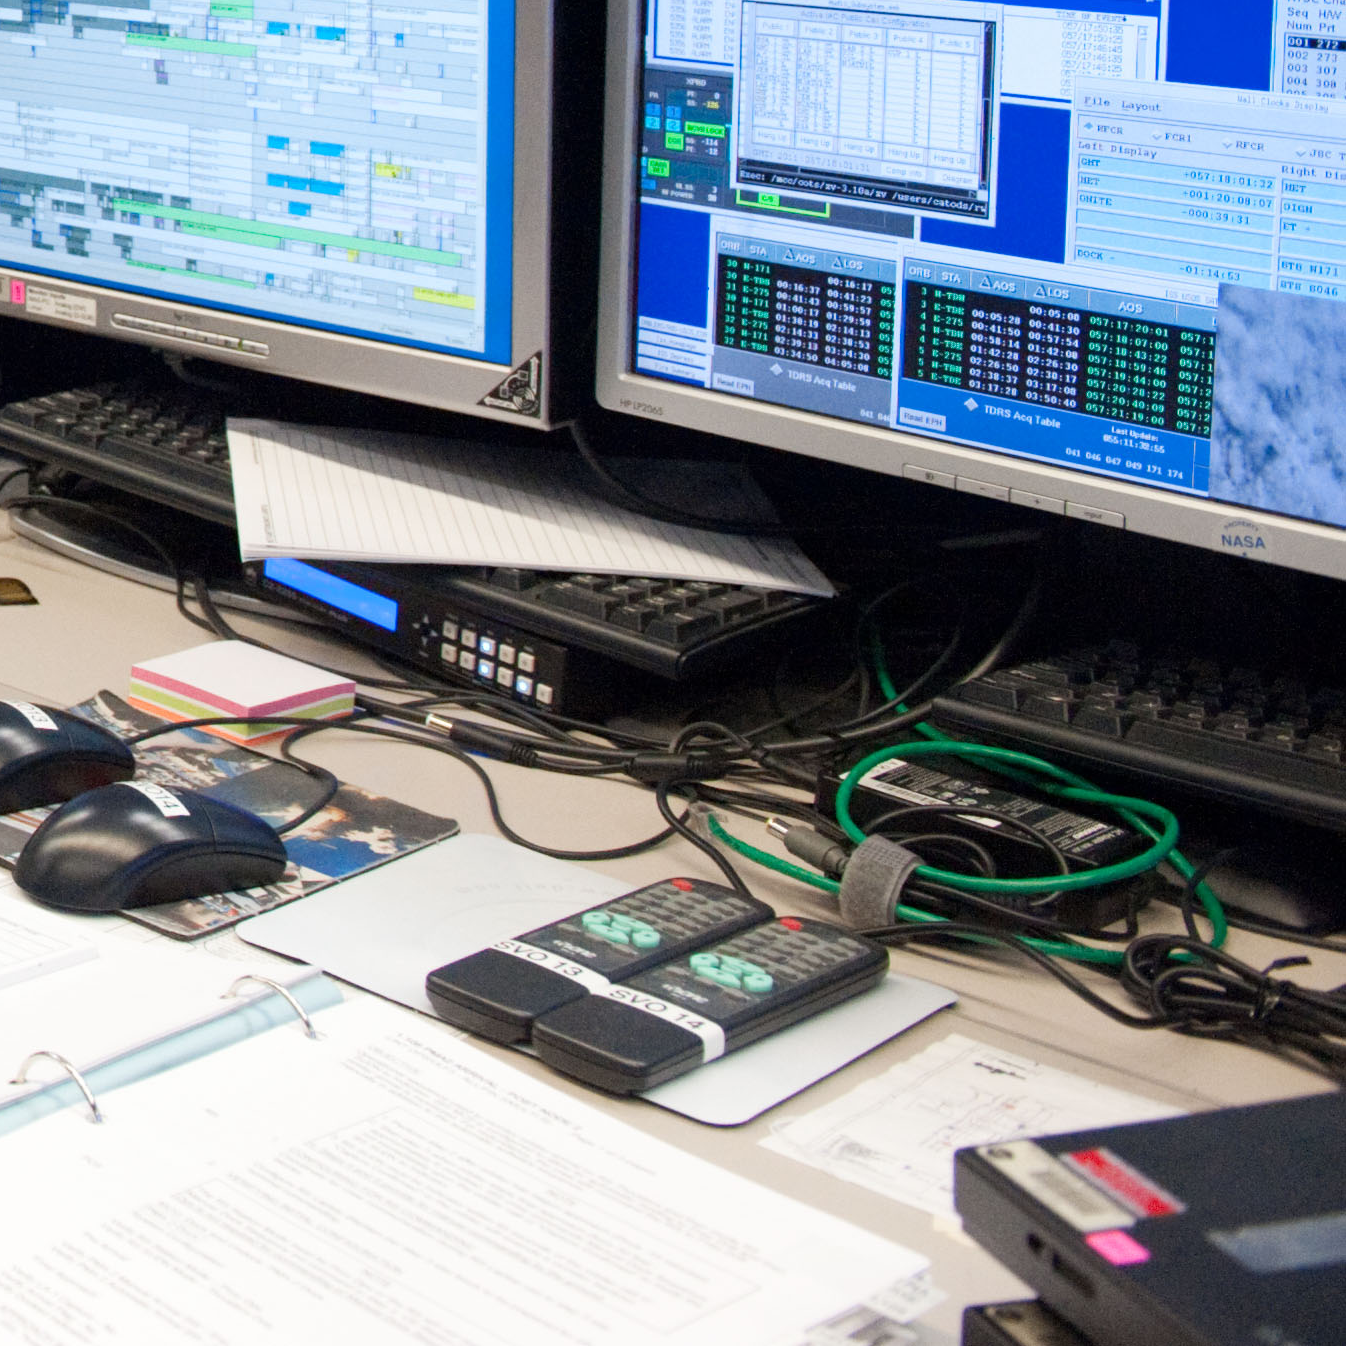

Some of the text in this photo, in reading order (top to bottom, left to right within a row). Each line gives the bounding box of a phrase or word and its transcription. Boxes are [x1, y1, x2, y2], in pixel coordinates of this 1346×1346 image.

[1287, 7, 1341, 19] Seq H/W
[1287, 21, 1312, 31] Num
[1288, 37, 1338, 49] 001 272
[1288, 50, 1337, 62] 002 273
[1287, 64, 1337, 74] 003 307
[1287, 77, 1307, 86] 004
[1085, 97, 1161, 112] File Layout
[1079, 141, 1157, 159] Left Display
[740, 171, 765, 180] Exec:
[1184, 171, 1273, 189] +057:18:01:32
[1281, 165, 1316, 178] Right
[1183, 190, 1272, 208] +001:20:08:07
[721, 242, 767, 257] ORB STA
[777, 280, 872, 304] 00:16:37 00:41:23
[828, 277, 872, 291] 00:16:17
[909, 267, 1142, 314] ORB STA AOS
[777, 291, 871, 315] 00:41:43 00:59:57
[776, 302, 870, 327] 01:00:17 01:29:59
[1030, 306, 1169, 338] 00:05:08 057:17:20:01
[775, 325, 818, 340] 02:14:33
[826, 322, 870, 338] 02:14:13
[972, 309, 1168, 351] 00:05:28 00:41:30 057:18:07:00
[972, 321, 1167, 364] 00:41:50 00:57:54 057:18:43:22
[774, 346, 818, 362] 03:34:50
[971, 333, 1166, 376] 00:58:14 01:42:08 057:18:59:46
[970, 344, 1166, 389] 01:42:28 02:26:30 057:19:44:00
[788, 370, 856, 392] TDRS Acq Table
[970, 356, 1165, 401] 02:26:50 057:20:28:22
[969, 368, 1165, 413] 02:38:37 03:17:08 057:20:40:09
[633, 402, 663, 415] LP2065
[969, 380, 1164, 426] 03:17:28 03:50:40 057:21:19:00
[984, 405, 1060, 429] TDRS Acq Table
[1111, 425, 1128, 435] Last
[1066, 448, 1080, 458] 041
[1086, 451, 1101, 462] 046
[1147, 464, 1162, 475] 171
[1167, 469, 1183, 480] 174
[1221, 535, 1265, 549] NASA
[494, 940, 549, 962] SVO
[553, 958, 583, 977] 13
[609, 989, 667, 1012] SVO
[675, 1013, 705, 1030] 14
